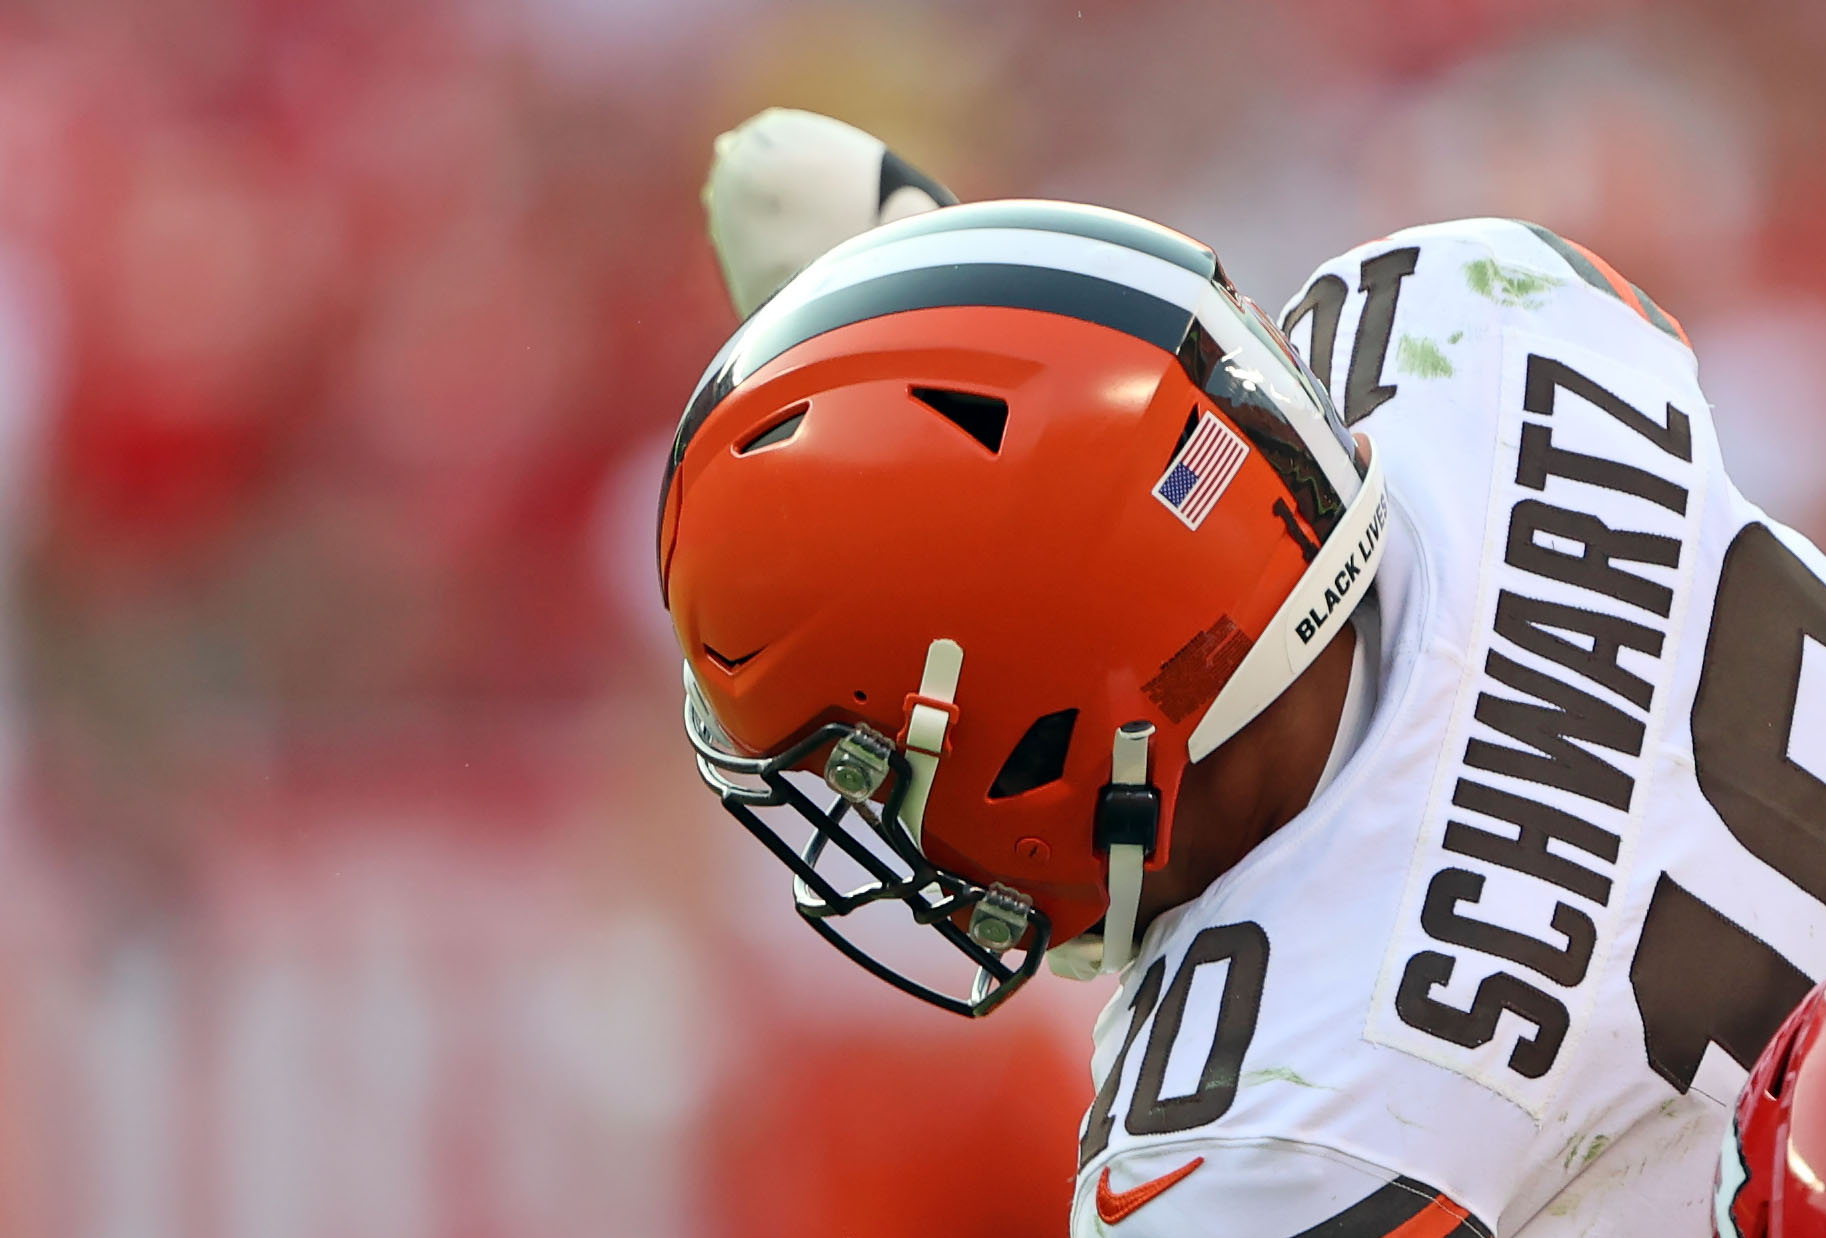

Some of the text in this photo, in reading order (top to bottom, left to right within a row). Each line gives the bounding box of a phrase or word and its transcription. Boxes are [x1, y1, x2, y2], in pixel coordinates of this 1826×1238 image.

[1294, 553, 1361, 645] BLACK
[1395, 352, 1694, 1080] SCHWARTZ
[1078, 920, 1271, 1175] 10
